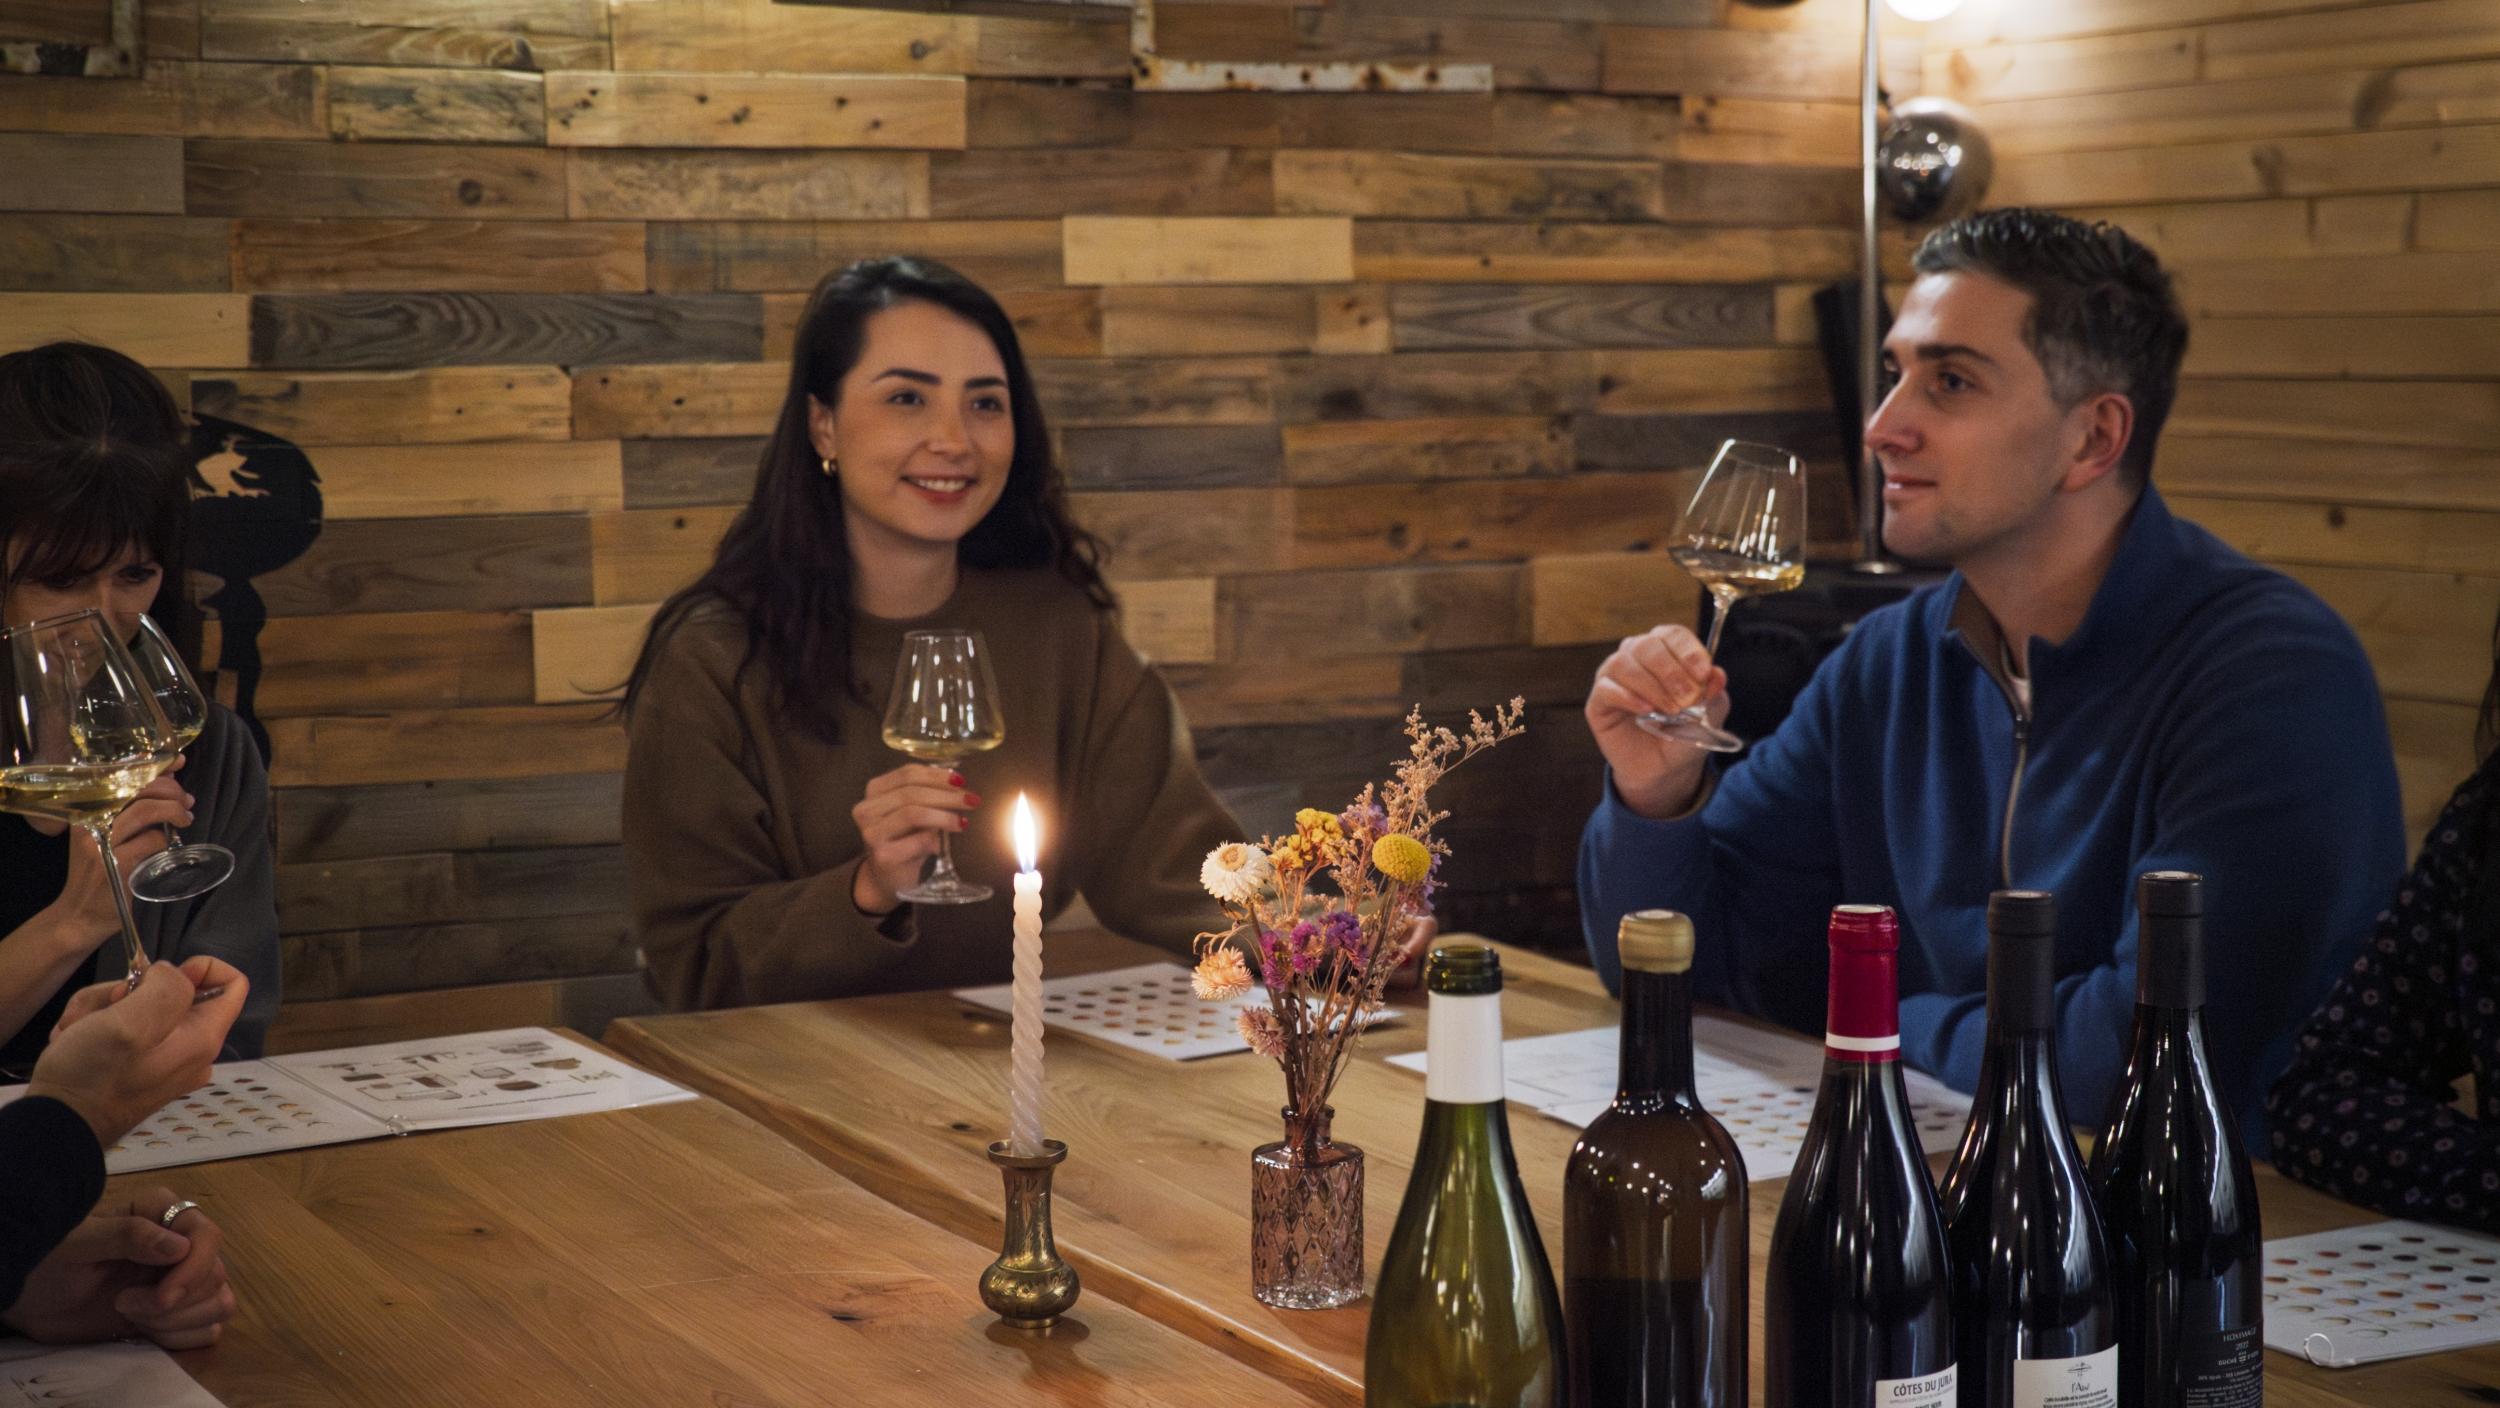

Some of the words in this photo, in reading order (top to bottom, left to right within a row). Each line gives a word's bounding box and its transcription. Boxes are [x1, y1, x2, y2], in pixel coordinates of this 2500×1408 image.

[1893, 1383, 1923, 1397] CÔTES
[1925, 1380, 1937, 1392] DU
[1938, 1373, 1953, 1391] JURA
